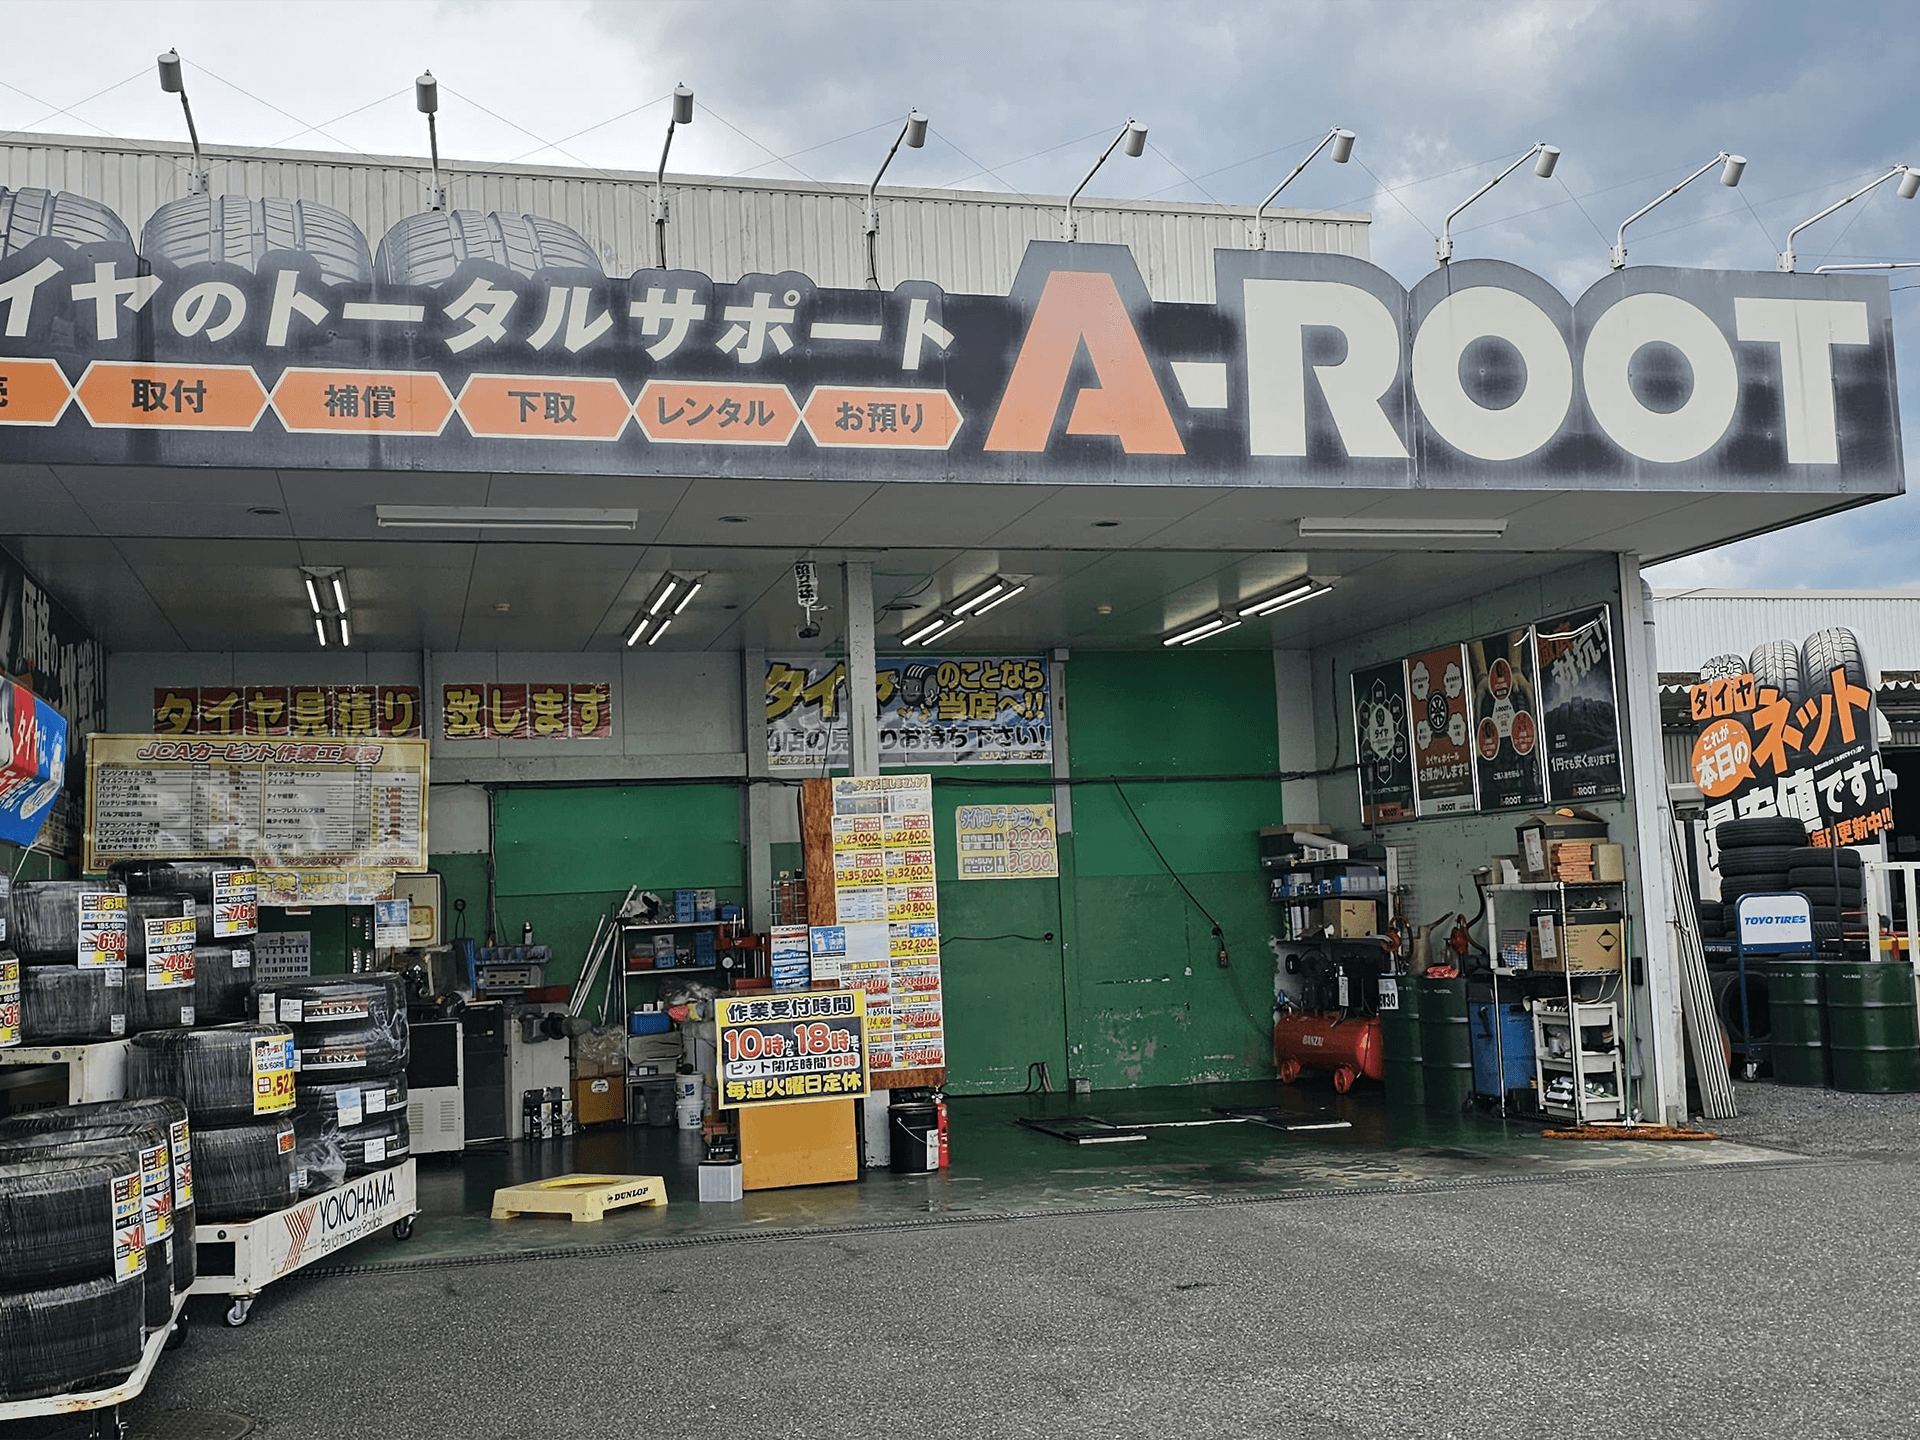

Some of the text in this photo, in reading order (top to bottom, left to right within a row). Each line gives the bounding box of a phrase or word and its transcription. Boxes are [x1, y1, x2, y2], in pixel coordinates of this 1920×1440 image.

[983, 270, 1870, 464] A-ROOT
[131, 379, 207, 414] 取付
[324, 385, 396, 420] 補償
[508, 391, 577, 424] 下取
[657, 396, 775, 427] レンタル
[834, 402, 924, 434] お預り
[937, 661, 1045, 689] のことなら
[156, 689, 416, 738] タイヤ見積り
[937, 691, 1045, 722] 当店へ!!
[1693, 667, 1871, 775] タイヤ ネット
[1702, 723, 1732, 751] これが
[1696, 741, 1748, 790] 本日の
[1744, 915, 1807, 926] TOYO TIRES
[311, 1005, 361, 1016] ALENZA
[727, 993, 855, 1023] 作業受付時間
[310, 1053, 360, 1064] ALENZA
[730, 1055, 856, 1076] ピット閉店時間19時
[726, 1072, 862, 1100] 毎週火曜日定休
[319, 1172, 395, 1234] YOKOHAMA
[614, 1187, 649, 1202] DUNLOP
